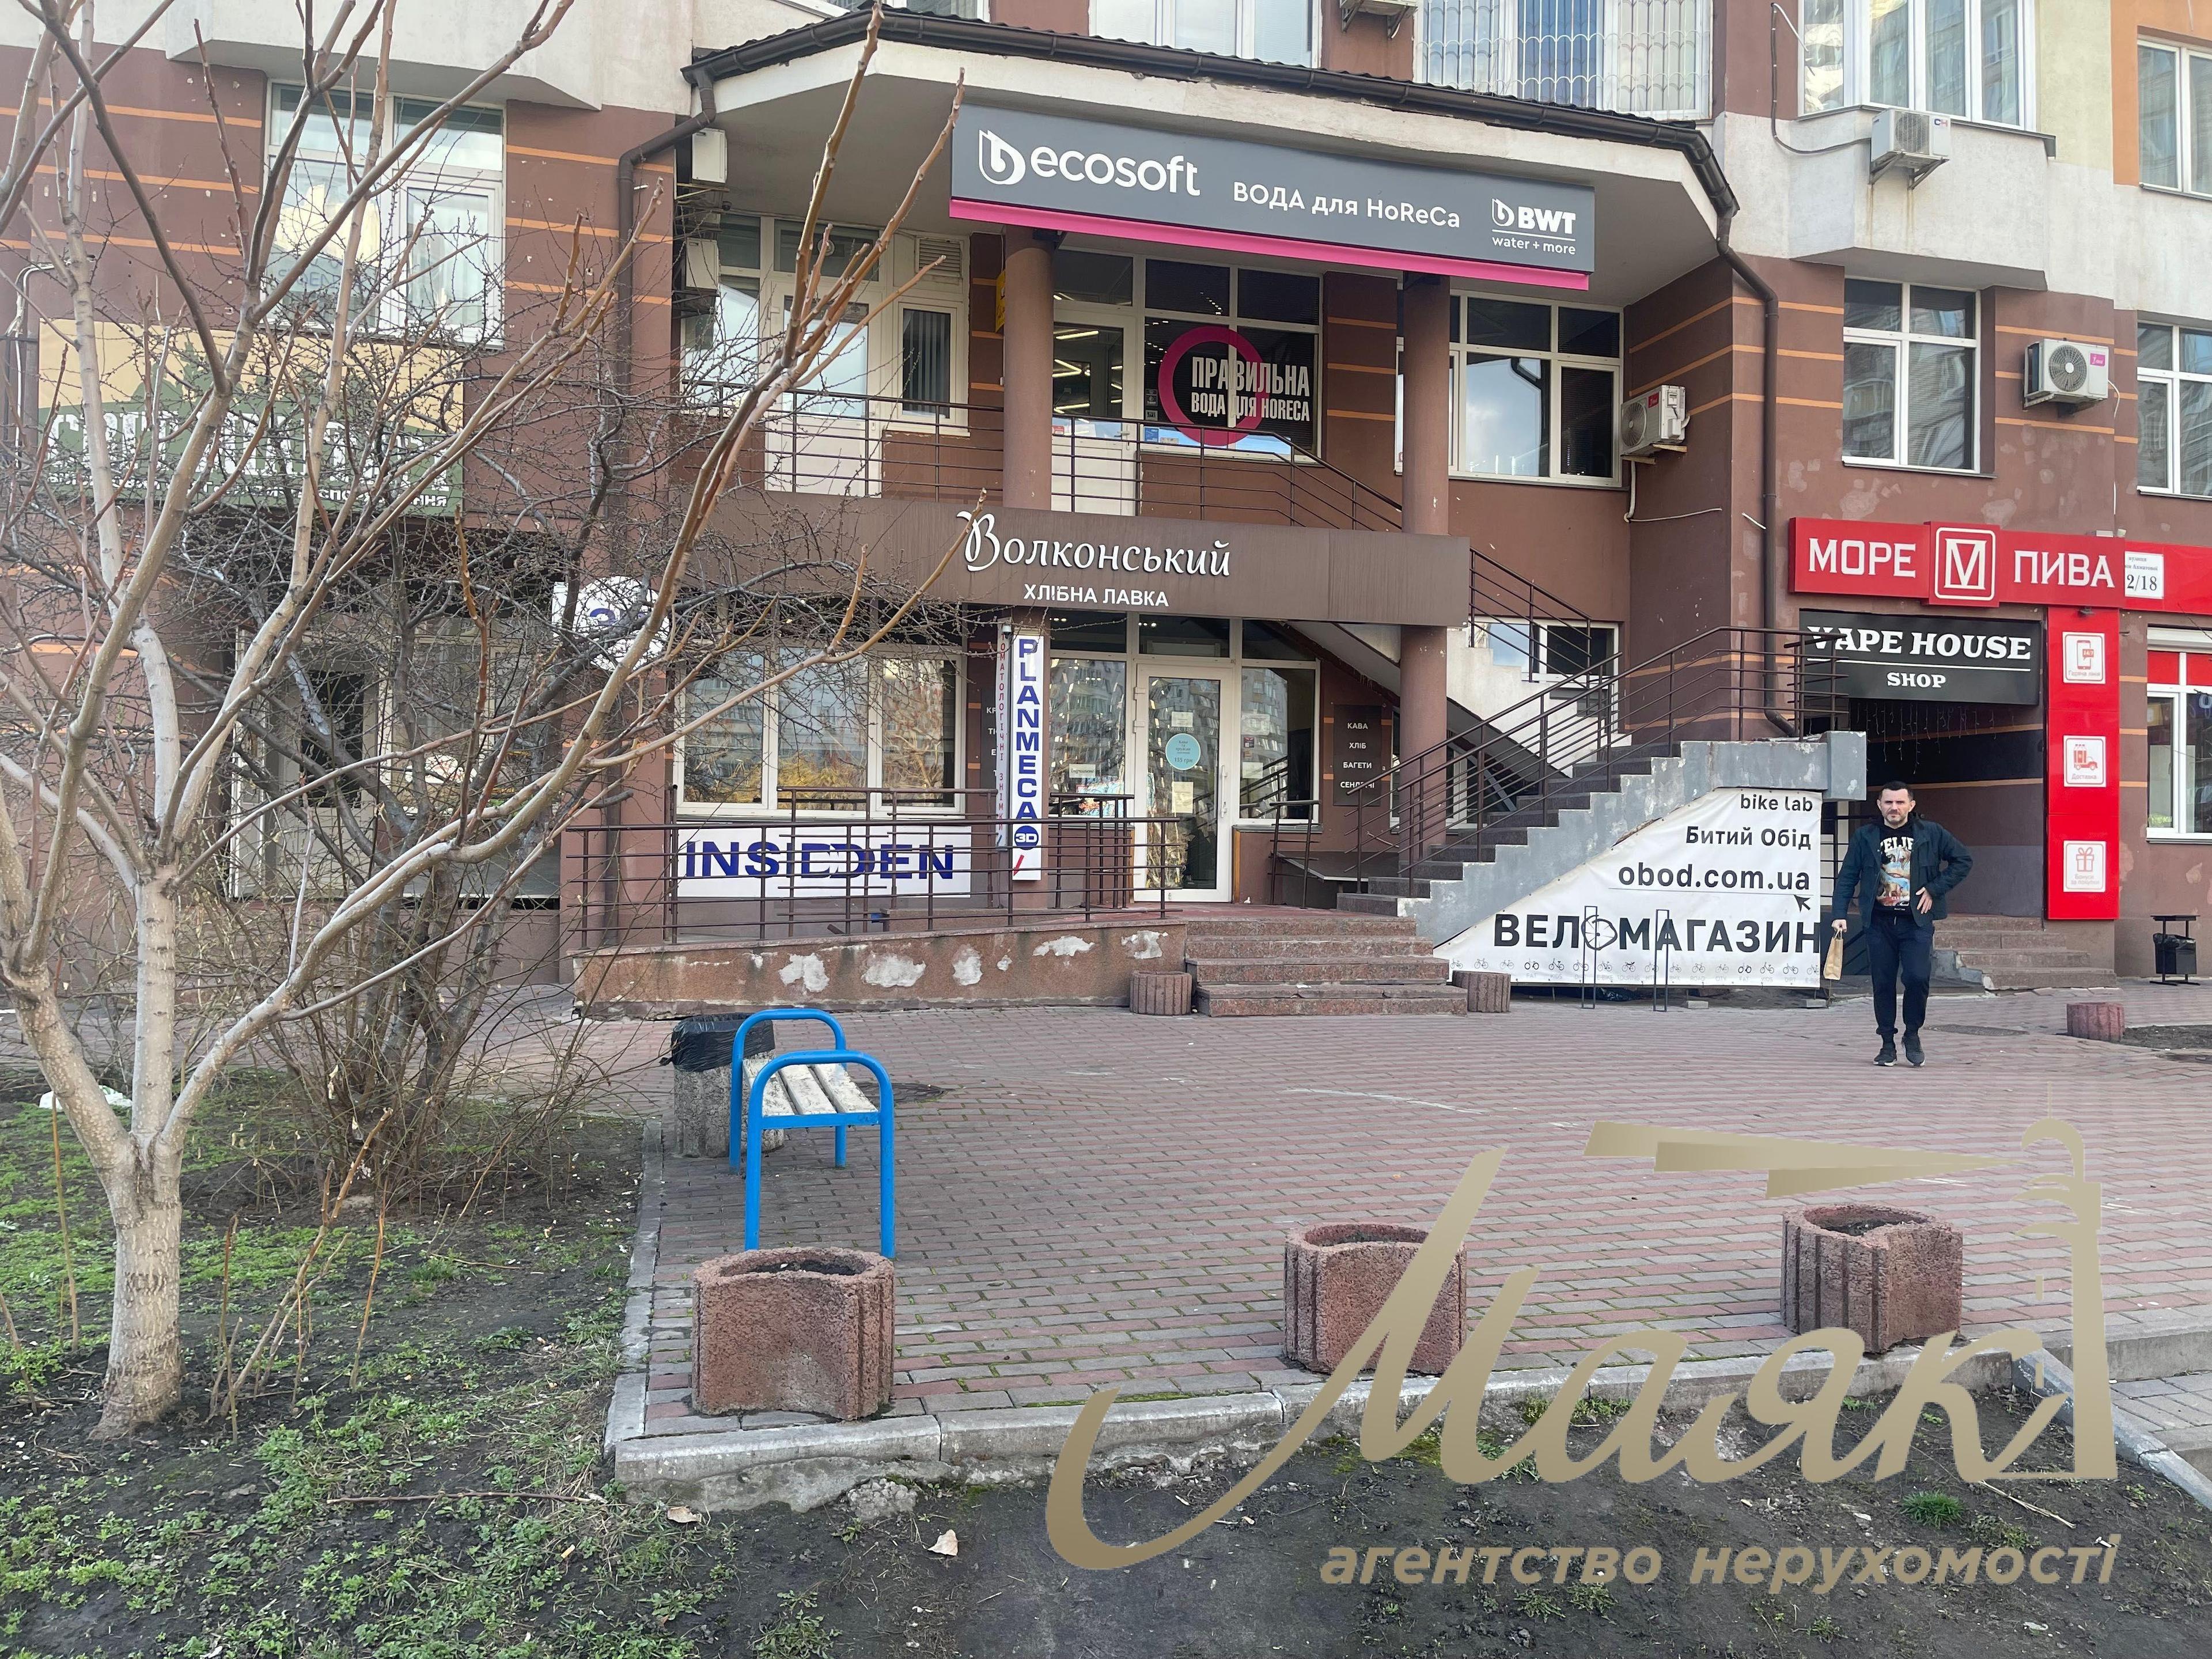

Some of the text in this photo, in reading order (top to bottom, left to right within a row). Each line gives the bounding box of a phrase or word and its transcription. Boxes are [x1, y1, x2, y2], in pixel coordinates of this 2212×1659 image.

[1030, 146, 1200, 196] ecosoft
[1233, 181, 1460, 228] ВОДА для HoReCa
[1518, 206, 1576, 234] BWT
[1492, 237, 1530, 249] water
[1543, 243, 1576, 255] more
[1191, 356, 1310, 397] ПРАВИЛЬНА
[1191, 391, 1226, 417] ВОДА
[957, 510, 1230, 577] Волконський
[1808, 537, 1916, 578] МОРЕ
[2014, 550, 2115, 588] ПИВА
[1024, 584, 1169, 607] ХЛІБНА ЛАВКА
[2127, 574, 2157, 592] 2/18
[1807, 626, 2031, 660] VAPE HOUSE
[1887, 672, 1946, 688] SHOP
[998, 632, 1006, 761] ТОМАТОЛОГІЧНІ
[1016, 638, 1041, 820] PLANMECA
[1740, 794, 1813, 812] bike lab
[1016, 833, 1037, 843] 3D
[1685, 825, 1811, 850] Битий Обід
[1618, 862, 1809, 891] obod.com.ua
[1494, 913, 1820, 954] ВЕЛОМАГАЗИН
